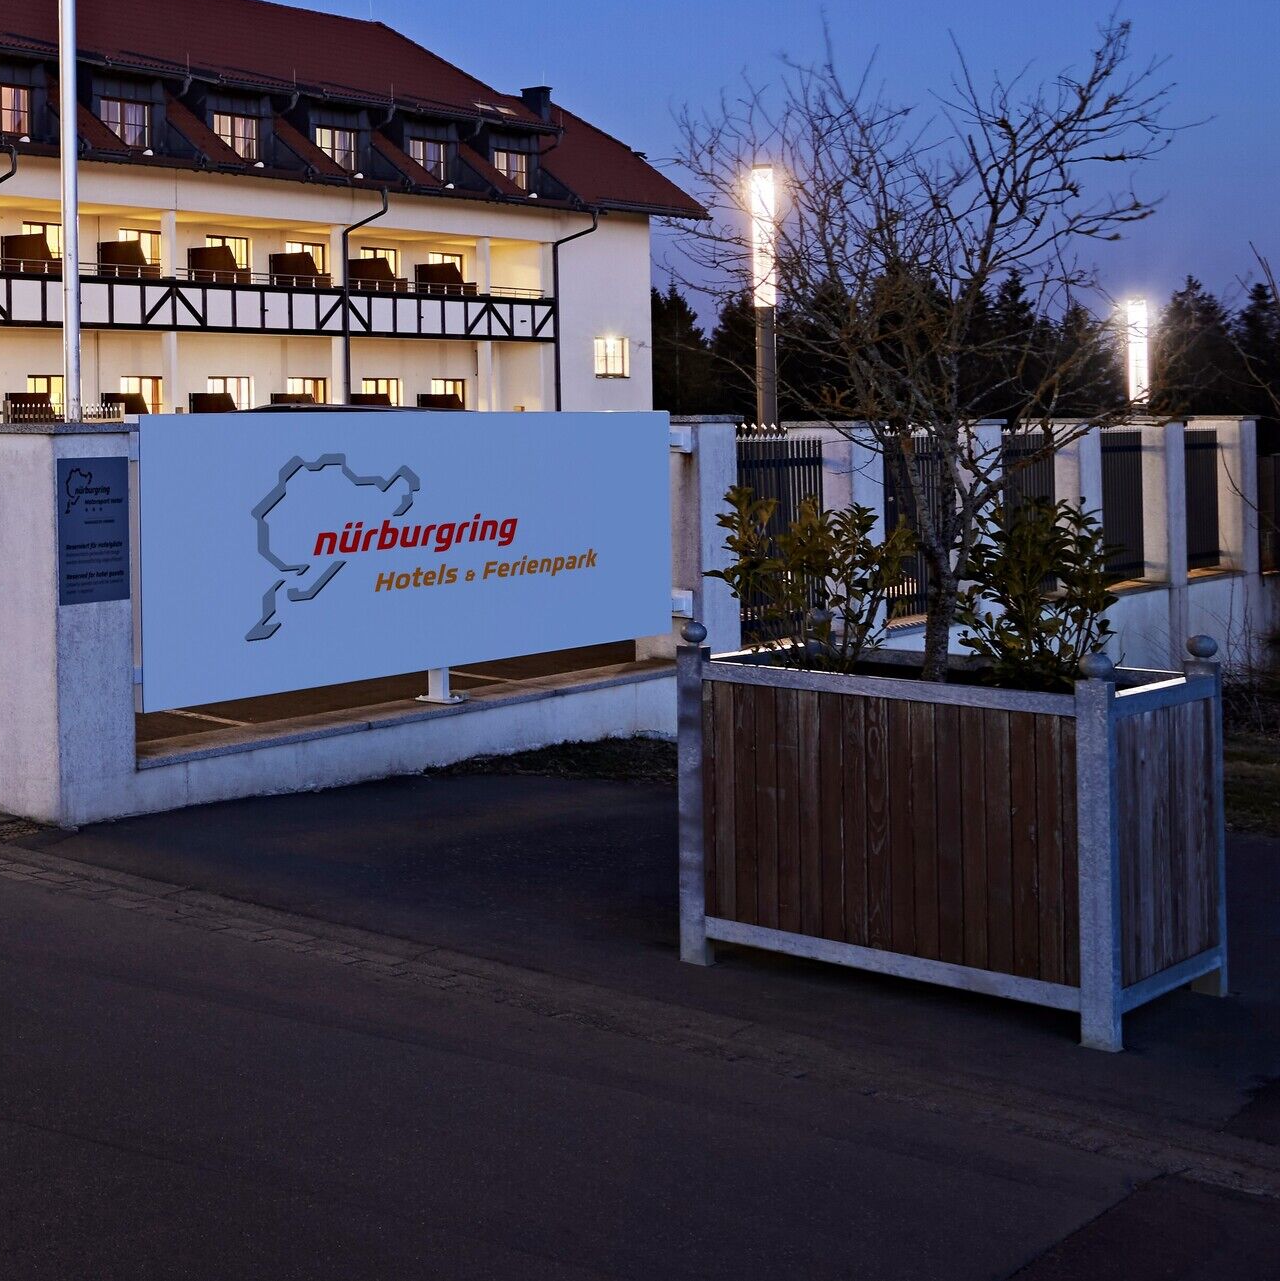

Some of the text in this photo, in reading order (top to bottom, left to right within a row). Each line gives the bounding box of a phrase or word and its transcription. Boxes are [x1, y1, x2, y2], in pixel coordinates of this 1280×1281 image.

[313, 513, 518, 556] nürburgring
[374, 548, 598, 592] Hotels & Ferienpark
